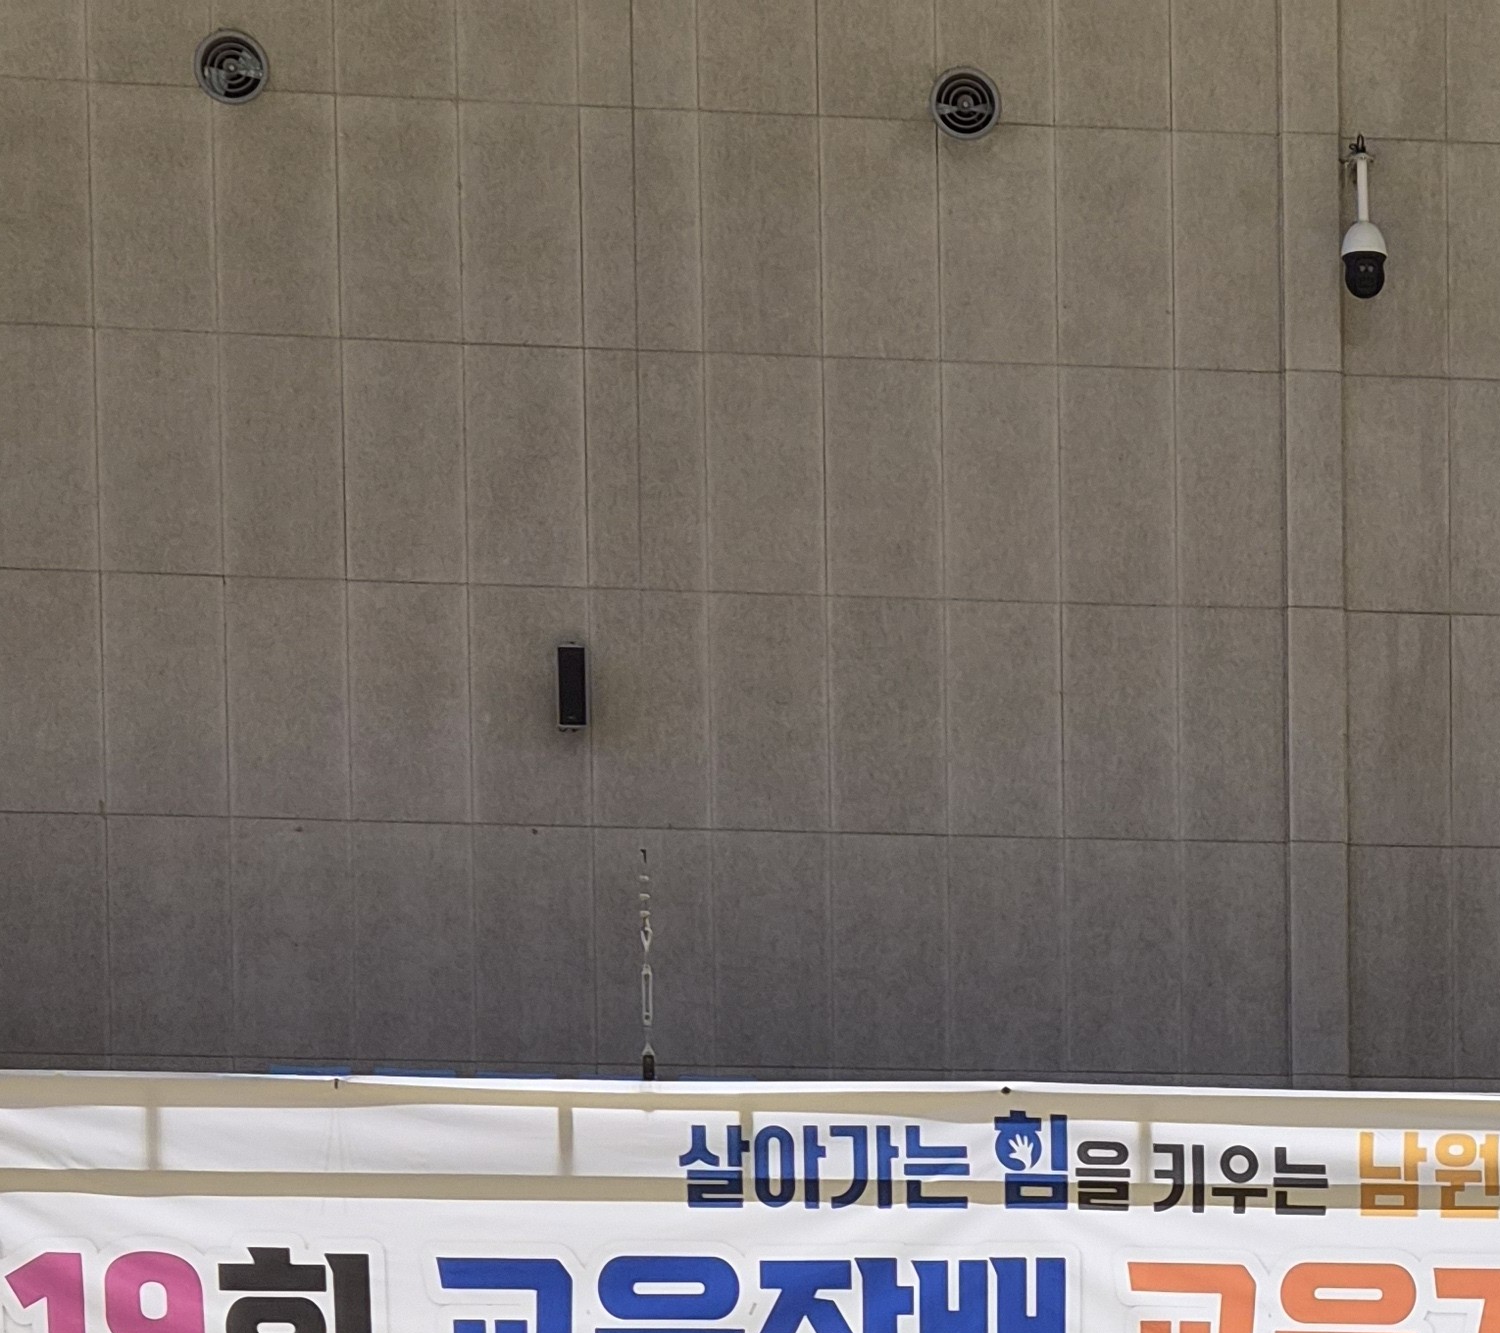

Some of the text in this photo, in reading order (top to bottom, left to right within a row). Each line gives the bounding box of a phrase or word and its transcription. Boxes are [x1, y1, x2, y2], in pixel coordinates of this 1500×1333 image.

[678, 1124, 971, 1211] 살아가는
[993, 1109, 1132, 1211] 힘을
[1152, 1143, 1330, 1217] 키우는
